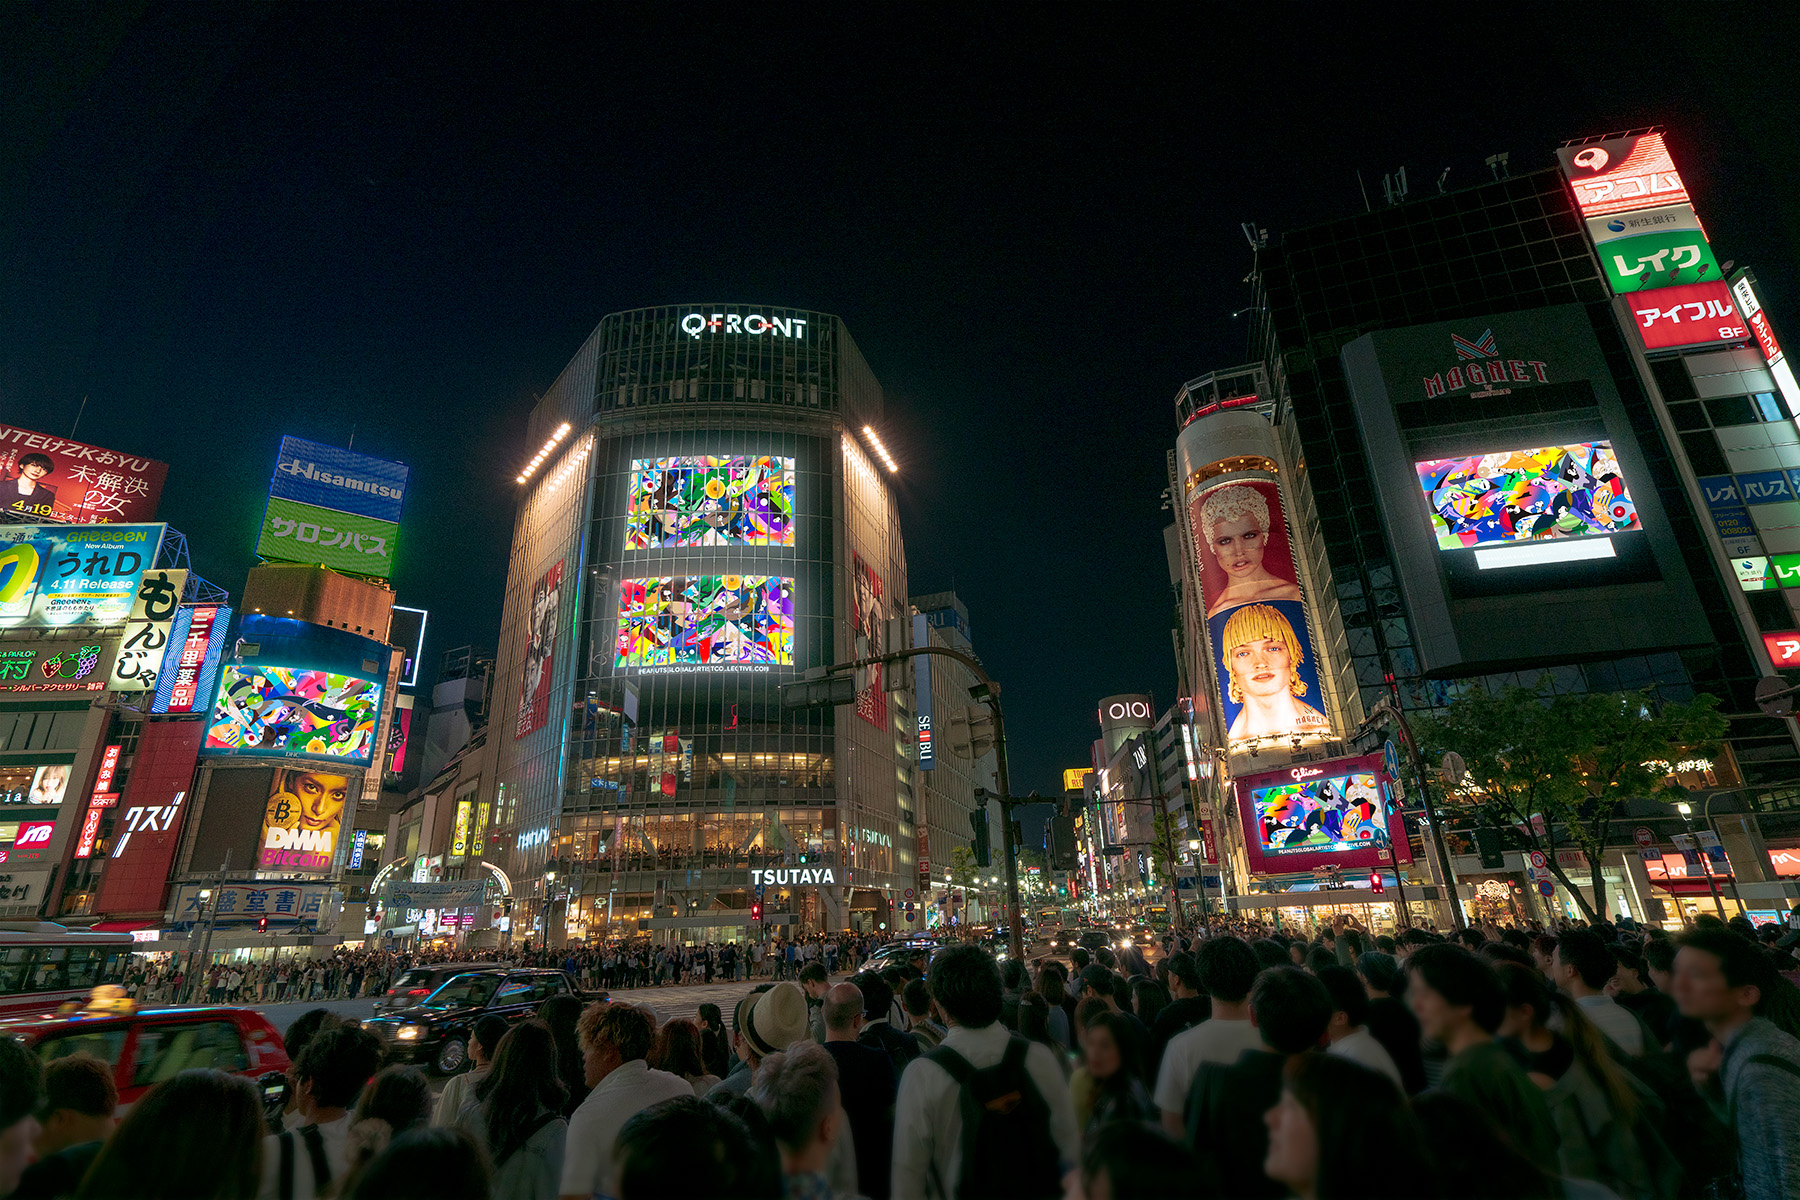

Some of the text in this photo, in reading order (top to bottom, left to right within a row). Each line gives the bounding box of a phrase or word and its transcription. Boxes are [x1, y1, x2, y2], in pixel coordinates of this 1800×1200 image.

[1584, 173, 1681, 203] アコム
[1629, 213, 1677, 228] 新生銀行
[1613, 245, 1701, 276] レイク
[681, 313, 807, 339] QFRONT
[1636, 299, 1733, 327] アイフル
[1718, 327, 1744, 339] 8F
[1756, 321, 1777, 356] アイフル
[1423, 359, 1549, 399] MAGNET
[67, 464, 149, 497] 未解決
[278, 459, 403, 500] Hisamitsu
[85, 490, 132, 516] の女
[1718, 518, 1739, 528] 0120
[66, 531, 147, 543] GReeeeN
[271, 516, 387, 558] サロンパス
[1737, 545, 1751, 555] 6F
[58, 551, 142, 577] うれD
[50, 578, 134, 590] 4.11 Release
[116, 572, 178, 687] もんじゃ
[7, 650, 37, 658] PARLOR
[169, 611, 210, 706] 三千里薬品
[16, 825, 53, 845] JTB
[264, 827, 332, 852] DMM
[261, 849, 330, 867] Bitcoin
[751, 868, 835, 885] TSUTAYA
